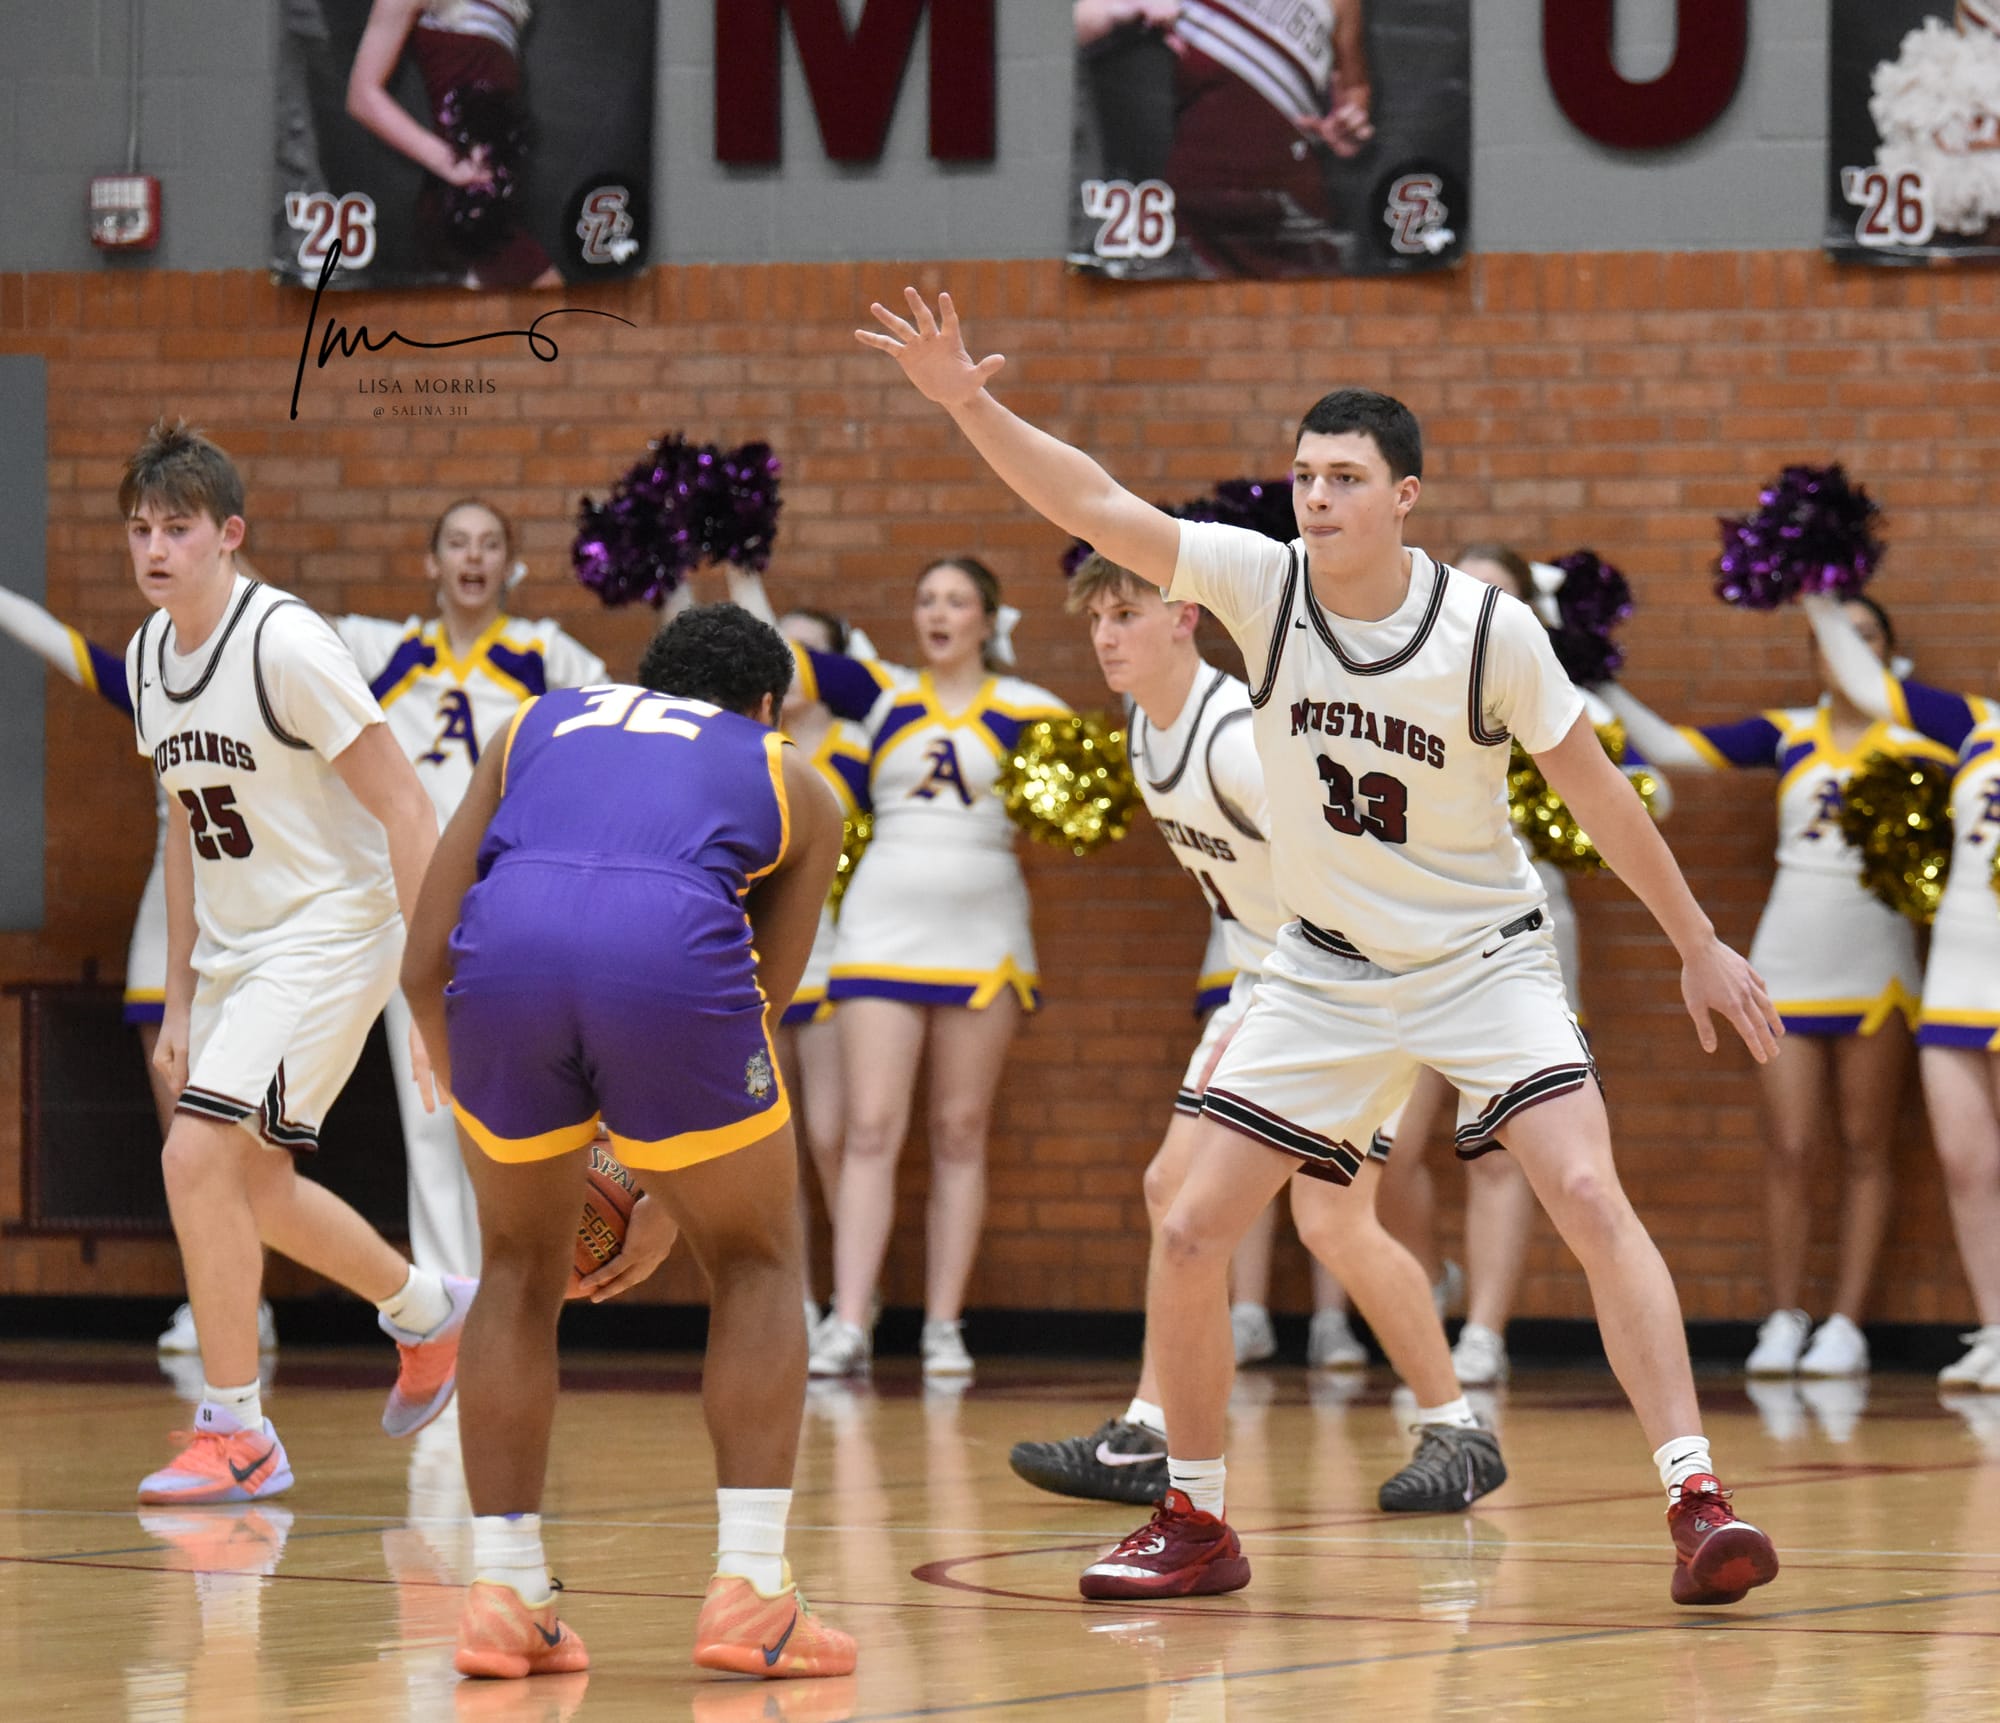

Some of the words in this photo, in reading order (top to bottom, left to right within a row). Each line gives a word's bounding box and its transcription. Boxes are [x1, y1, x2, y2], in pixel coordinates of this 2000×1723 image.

[1082, 181, 1175, 258] '26
[414, 688, 480, 767] A
[553, 683, 724, 741] 32
[1290, 698, 1446, 770] MUSTANGS
[153, 730, 257, 776] USTANGS
[905, 738, 977, 808] A
[178, 784, 254, 861] 25
[1317, 753, 1407, 844] 33
